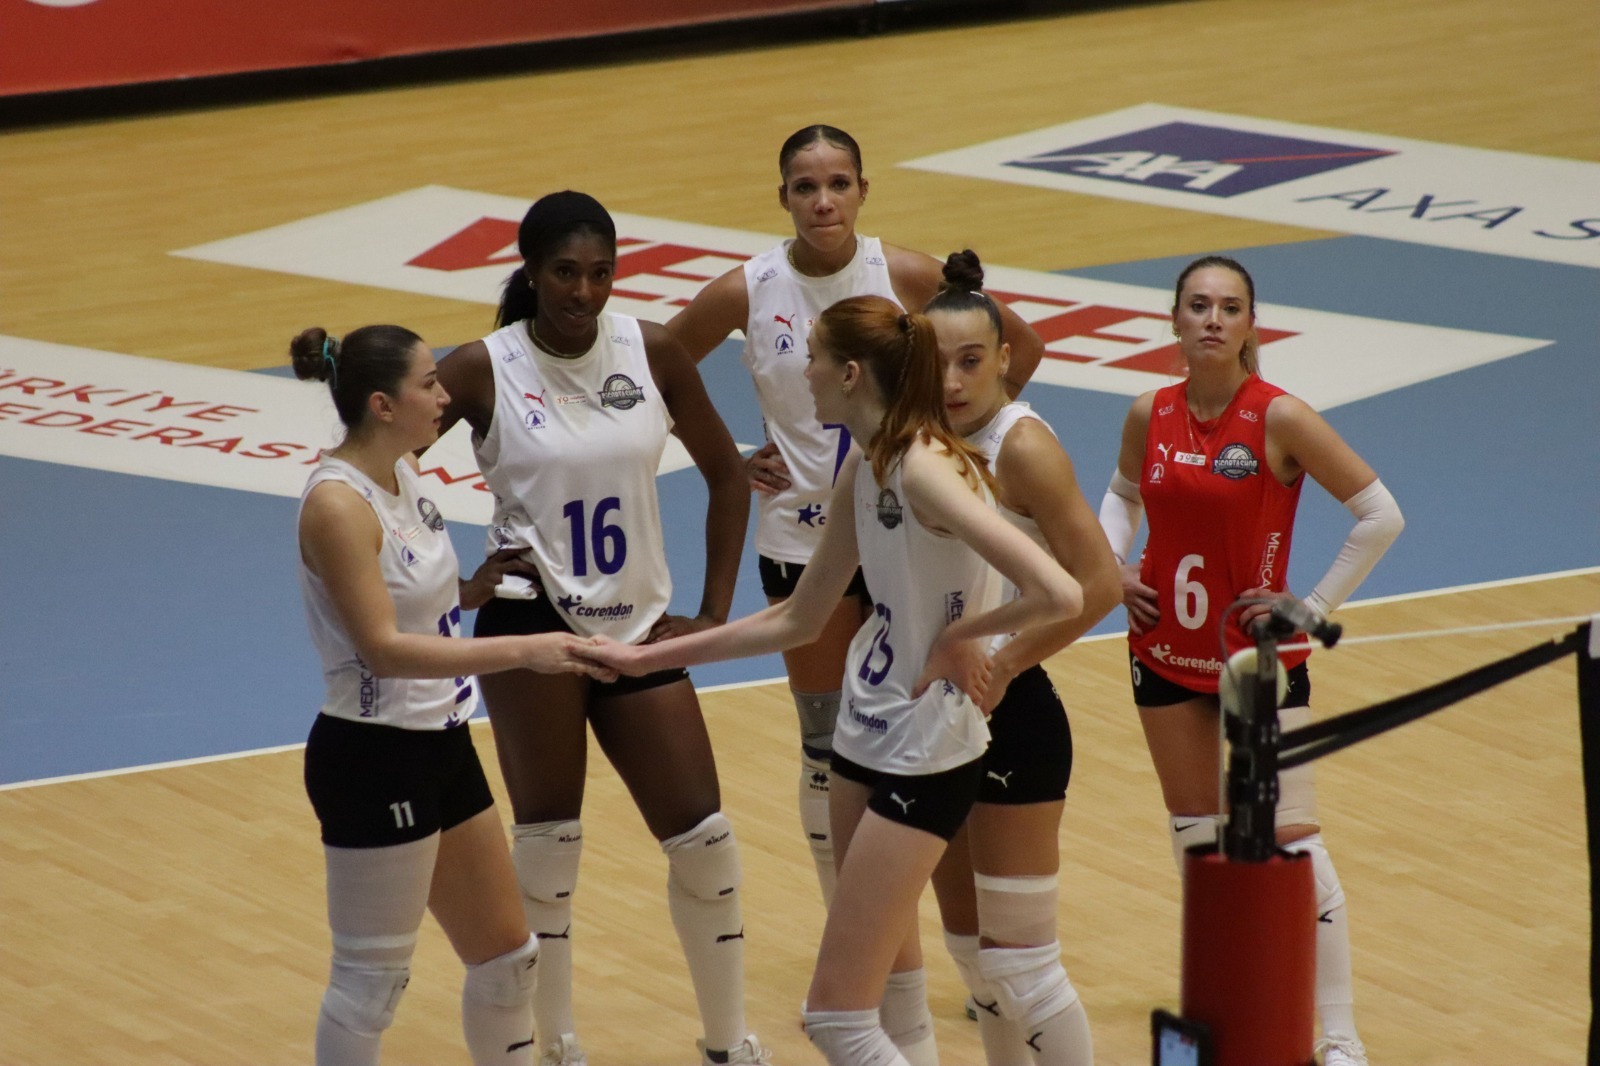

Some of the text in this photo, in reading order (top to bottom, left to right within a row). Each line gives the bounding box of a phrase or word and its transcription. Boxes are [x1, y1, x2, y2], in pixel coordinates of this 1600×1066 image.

[1012, 150, 1240, 190] AXA
[1295, 187, 1525, 229] AXA
[563, 496, 627, 576] 16
[576, 603, 634, 617] corendon
[1174, 553, 1208, 630] 6
[1169, 655, 1225, 672] corendo
[389, 800, 415, 829] 11
